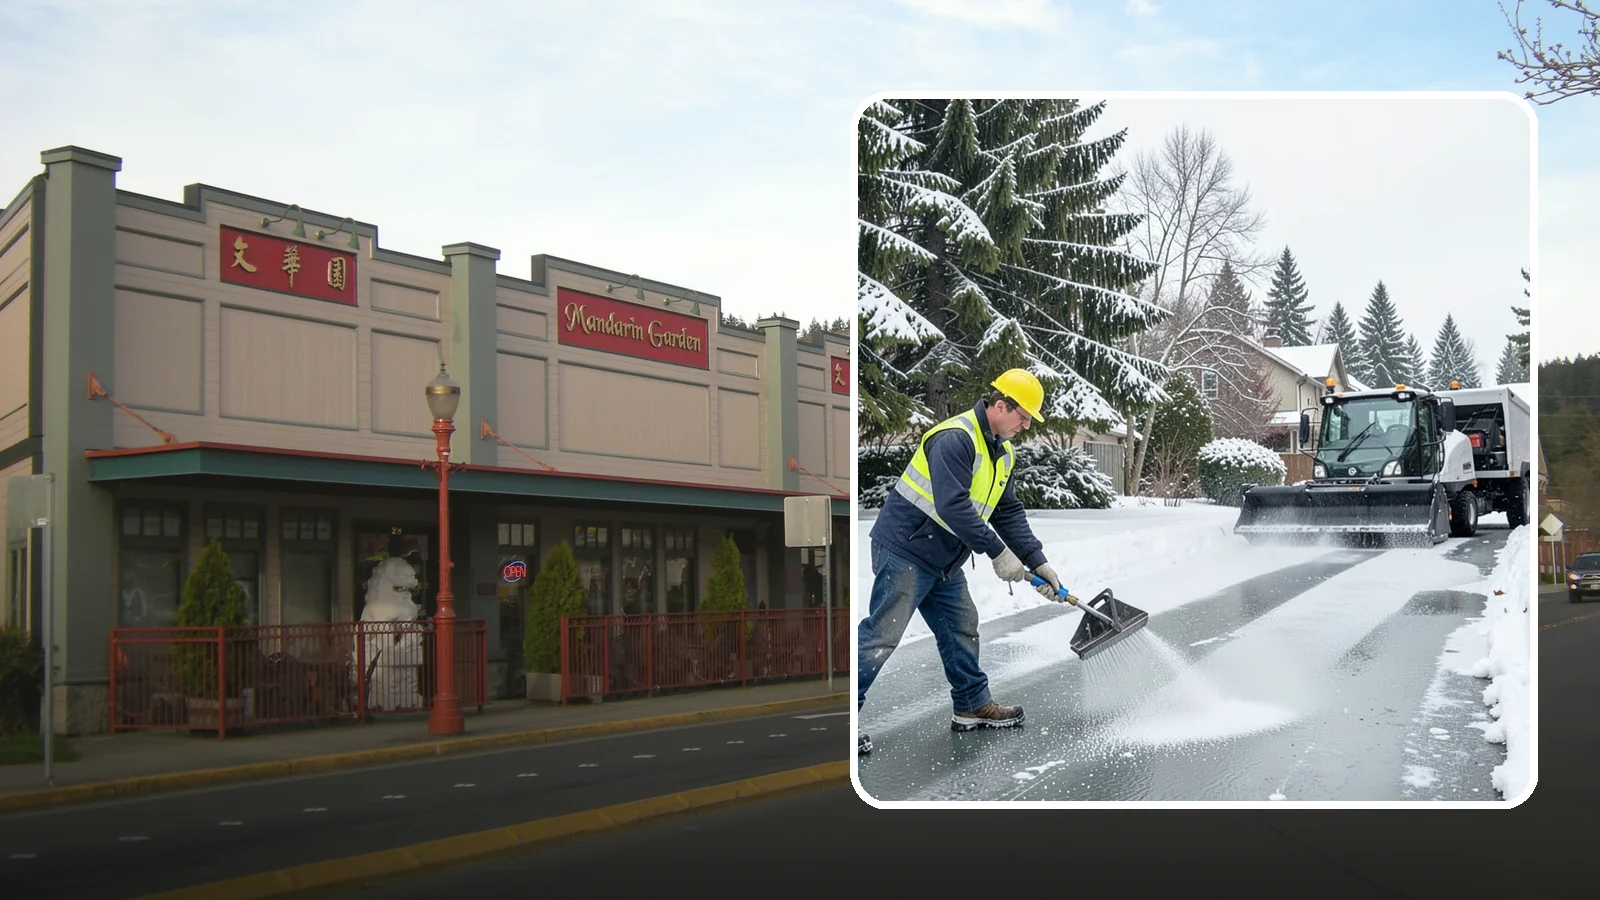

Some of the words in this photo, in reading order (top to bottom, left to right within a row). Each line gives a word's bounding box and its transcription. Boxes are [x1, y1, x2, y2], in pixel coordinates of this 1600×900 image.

[231, 236, 346, 291] 文華園
[564, 302, 643, 340] Mandarin
[648, 320, 701, 352] Garden
[503, 565, 526, 578] OPEN
